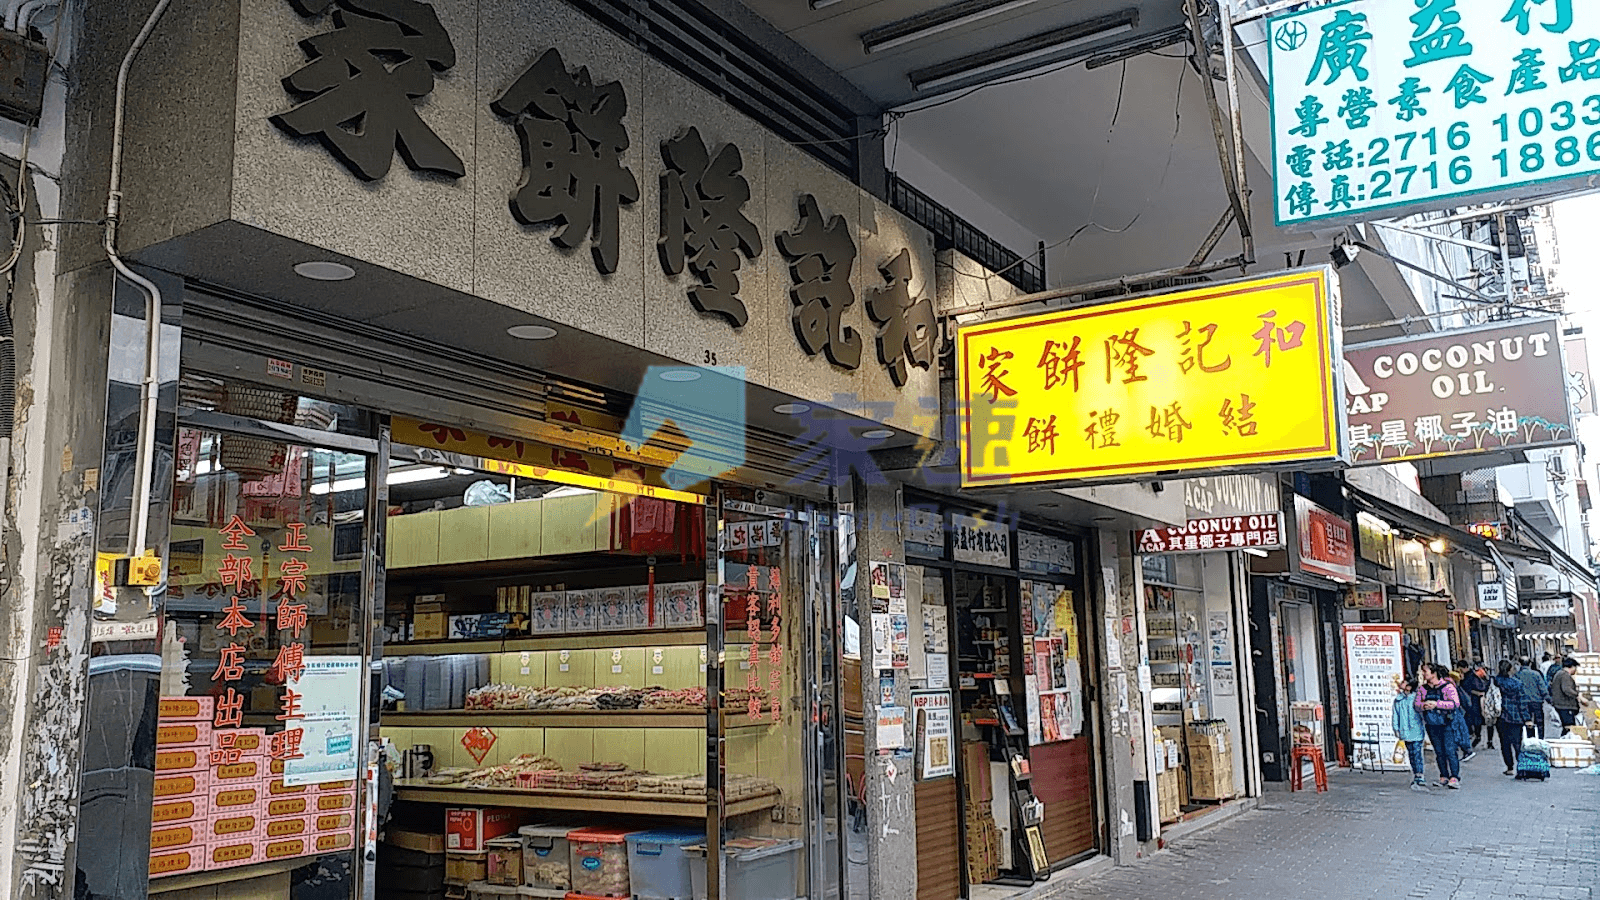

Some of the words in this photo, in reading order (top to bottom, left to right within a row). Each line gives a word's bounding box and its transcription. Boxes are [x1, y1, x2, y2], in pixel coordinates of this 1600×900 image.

[1492, 95, 1600, 143] 1033
[703, 349, 717, 367] 35
[1374, 331, 1552, 376] COCONUT
[1431, 370, 1495, 400] OIL
[1348, 406, 1519, 448] 其星椰子油
[1248, 515, 1277, 531] OIL
[1168, 530, 1278, 551] 其星椰子專門店
[210, 514, 256, 766] 全部本店出品
[271, 521, 313, 761] 正宗師傅主理
[1354, 633, 1394, 647] 金泰皇
[914, 696, 928, 708] NBP
